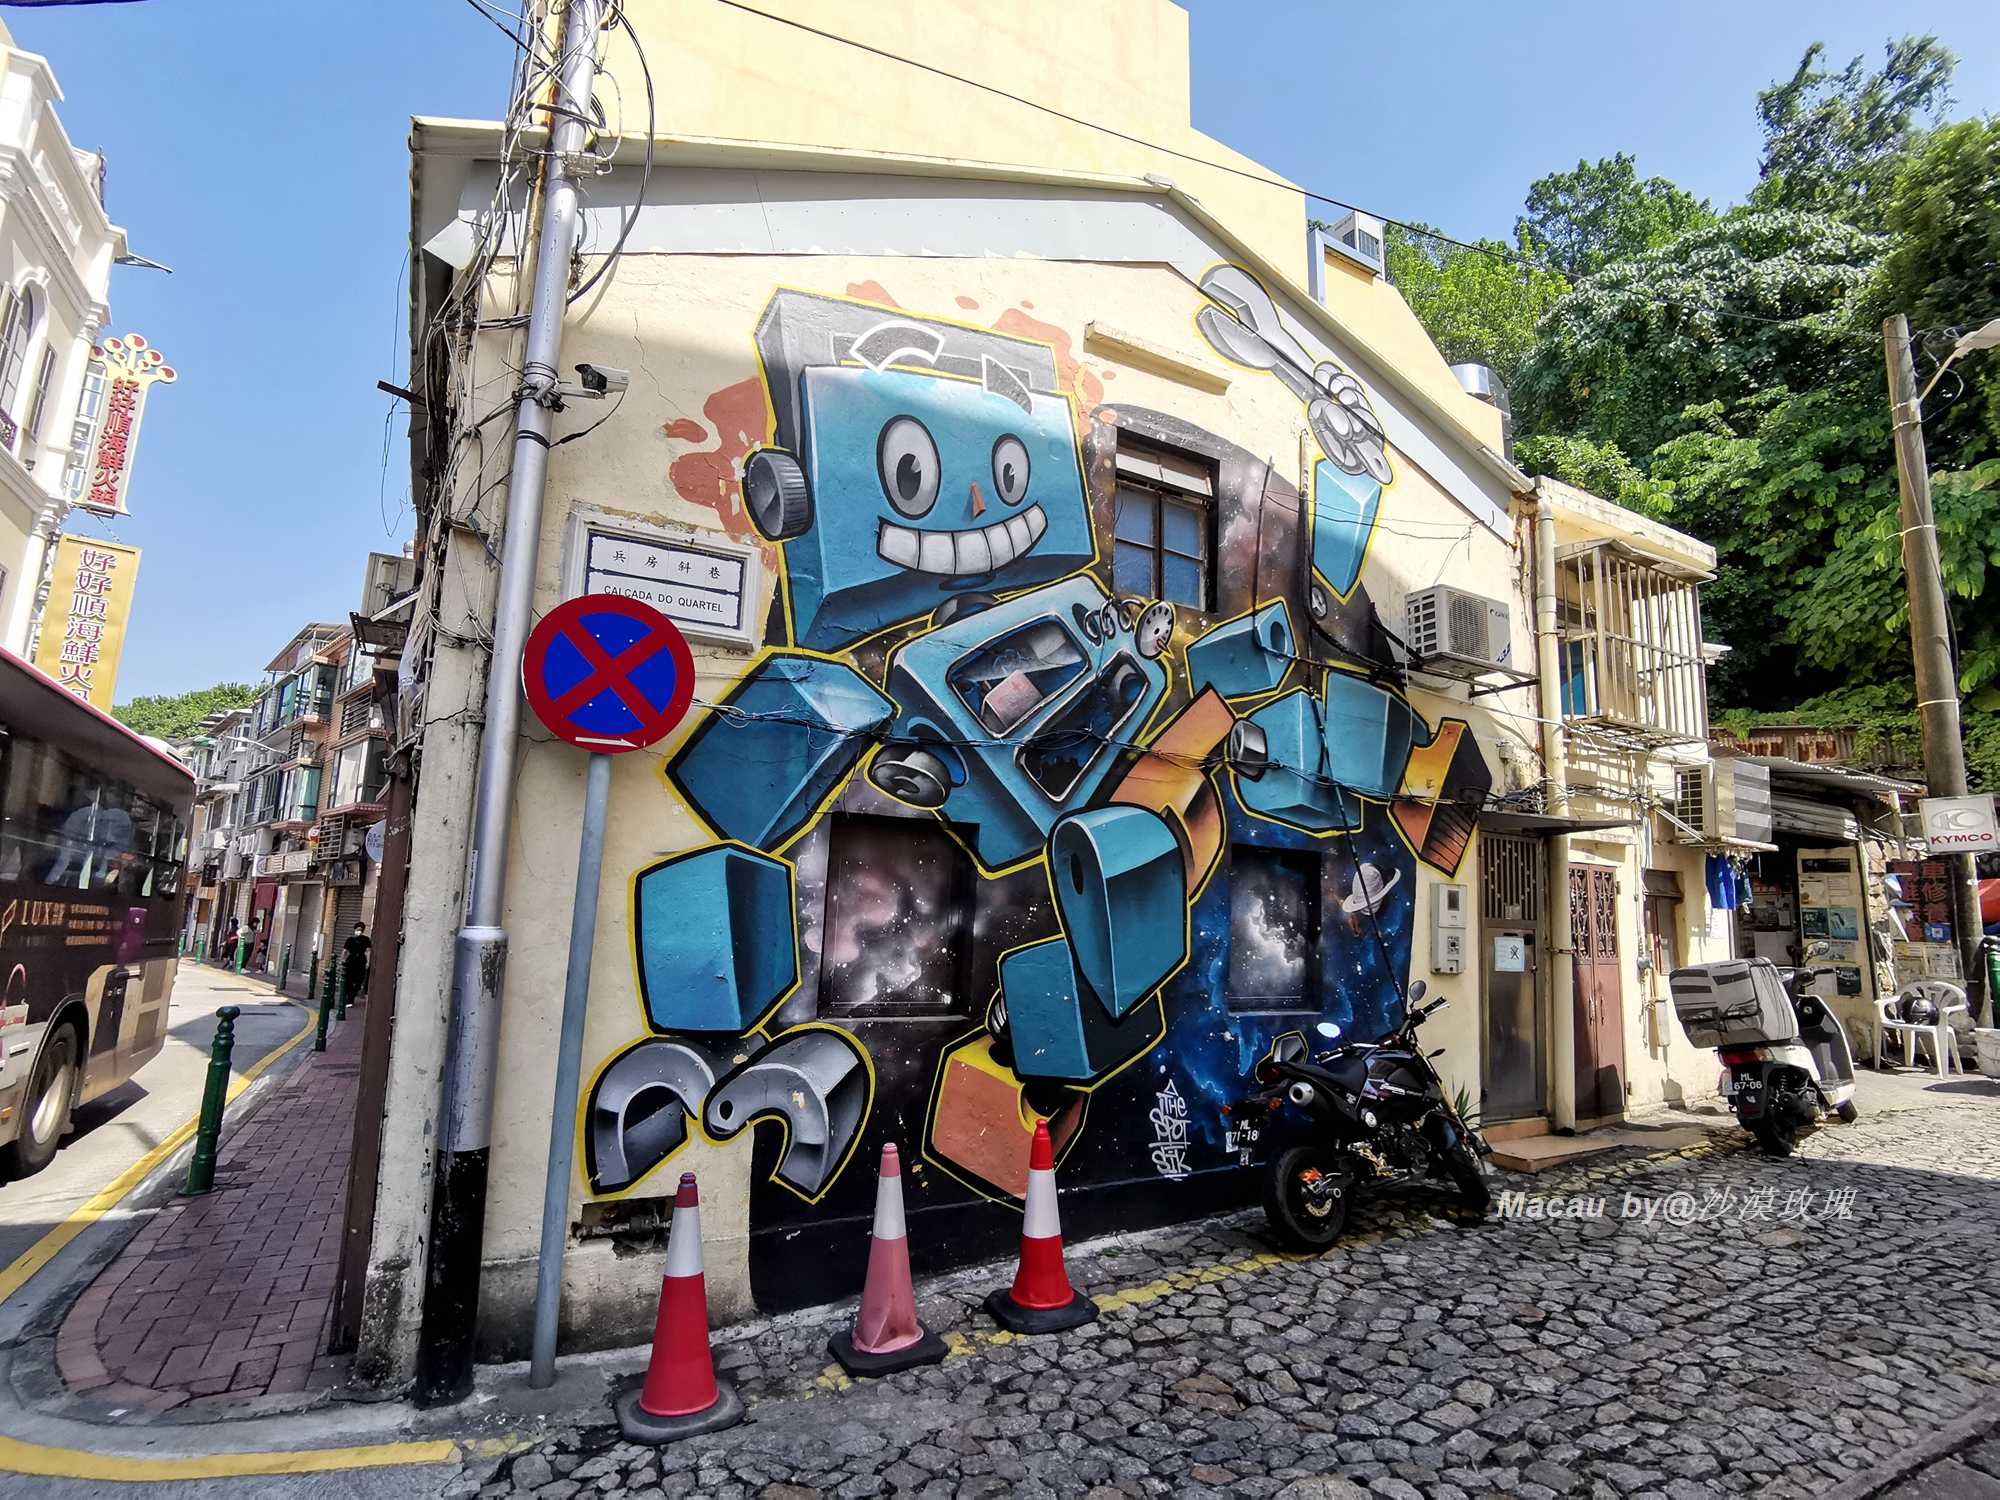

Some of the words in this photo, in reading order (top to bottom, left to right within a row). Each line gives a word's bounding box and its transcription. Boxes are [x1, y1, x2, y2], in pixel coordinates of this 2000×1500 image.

[612, 550, 721, 580] 兵房斜巷
[658, 593, 673, 604] DO
[678, 597, 724, 613] QUARTEL
[57, 548, 117, 704] 好好順海鮮火
[1930, 833, 1993, 845] KYMCO
[1740, 1073, 1754, 1081] ML
[1734, 1081, 1762, 1090] 67-06
[1240, 1119, 1251, 1130] ML
[1232, 1130, 1258, 1143] 71-18
